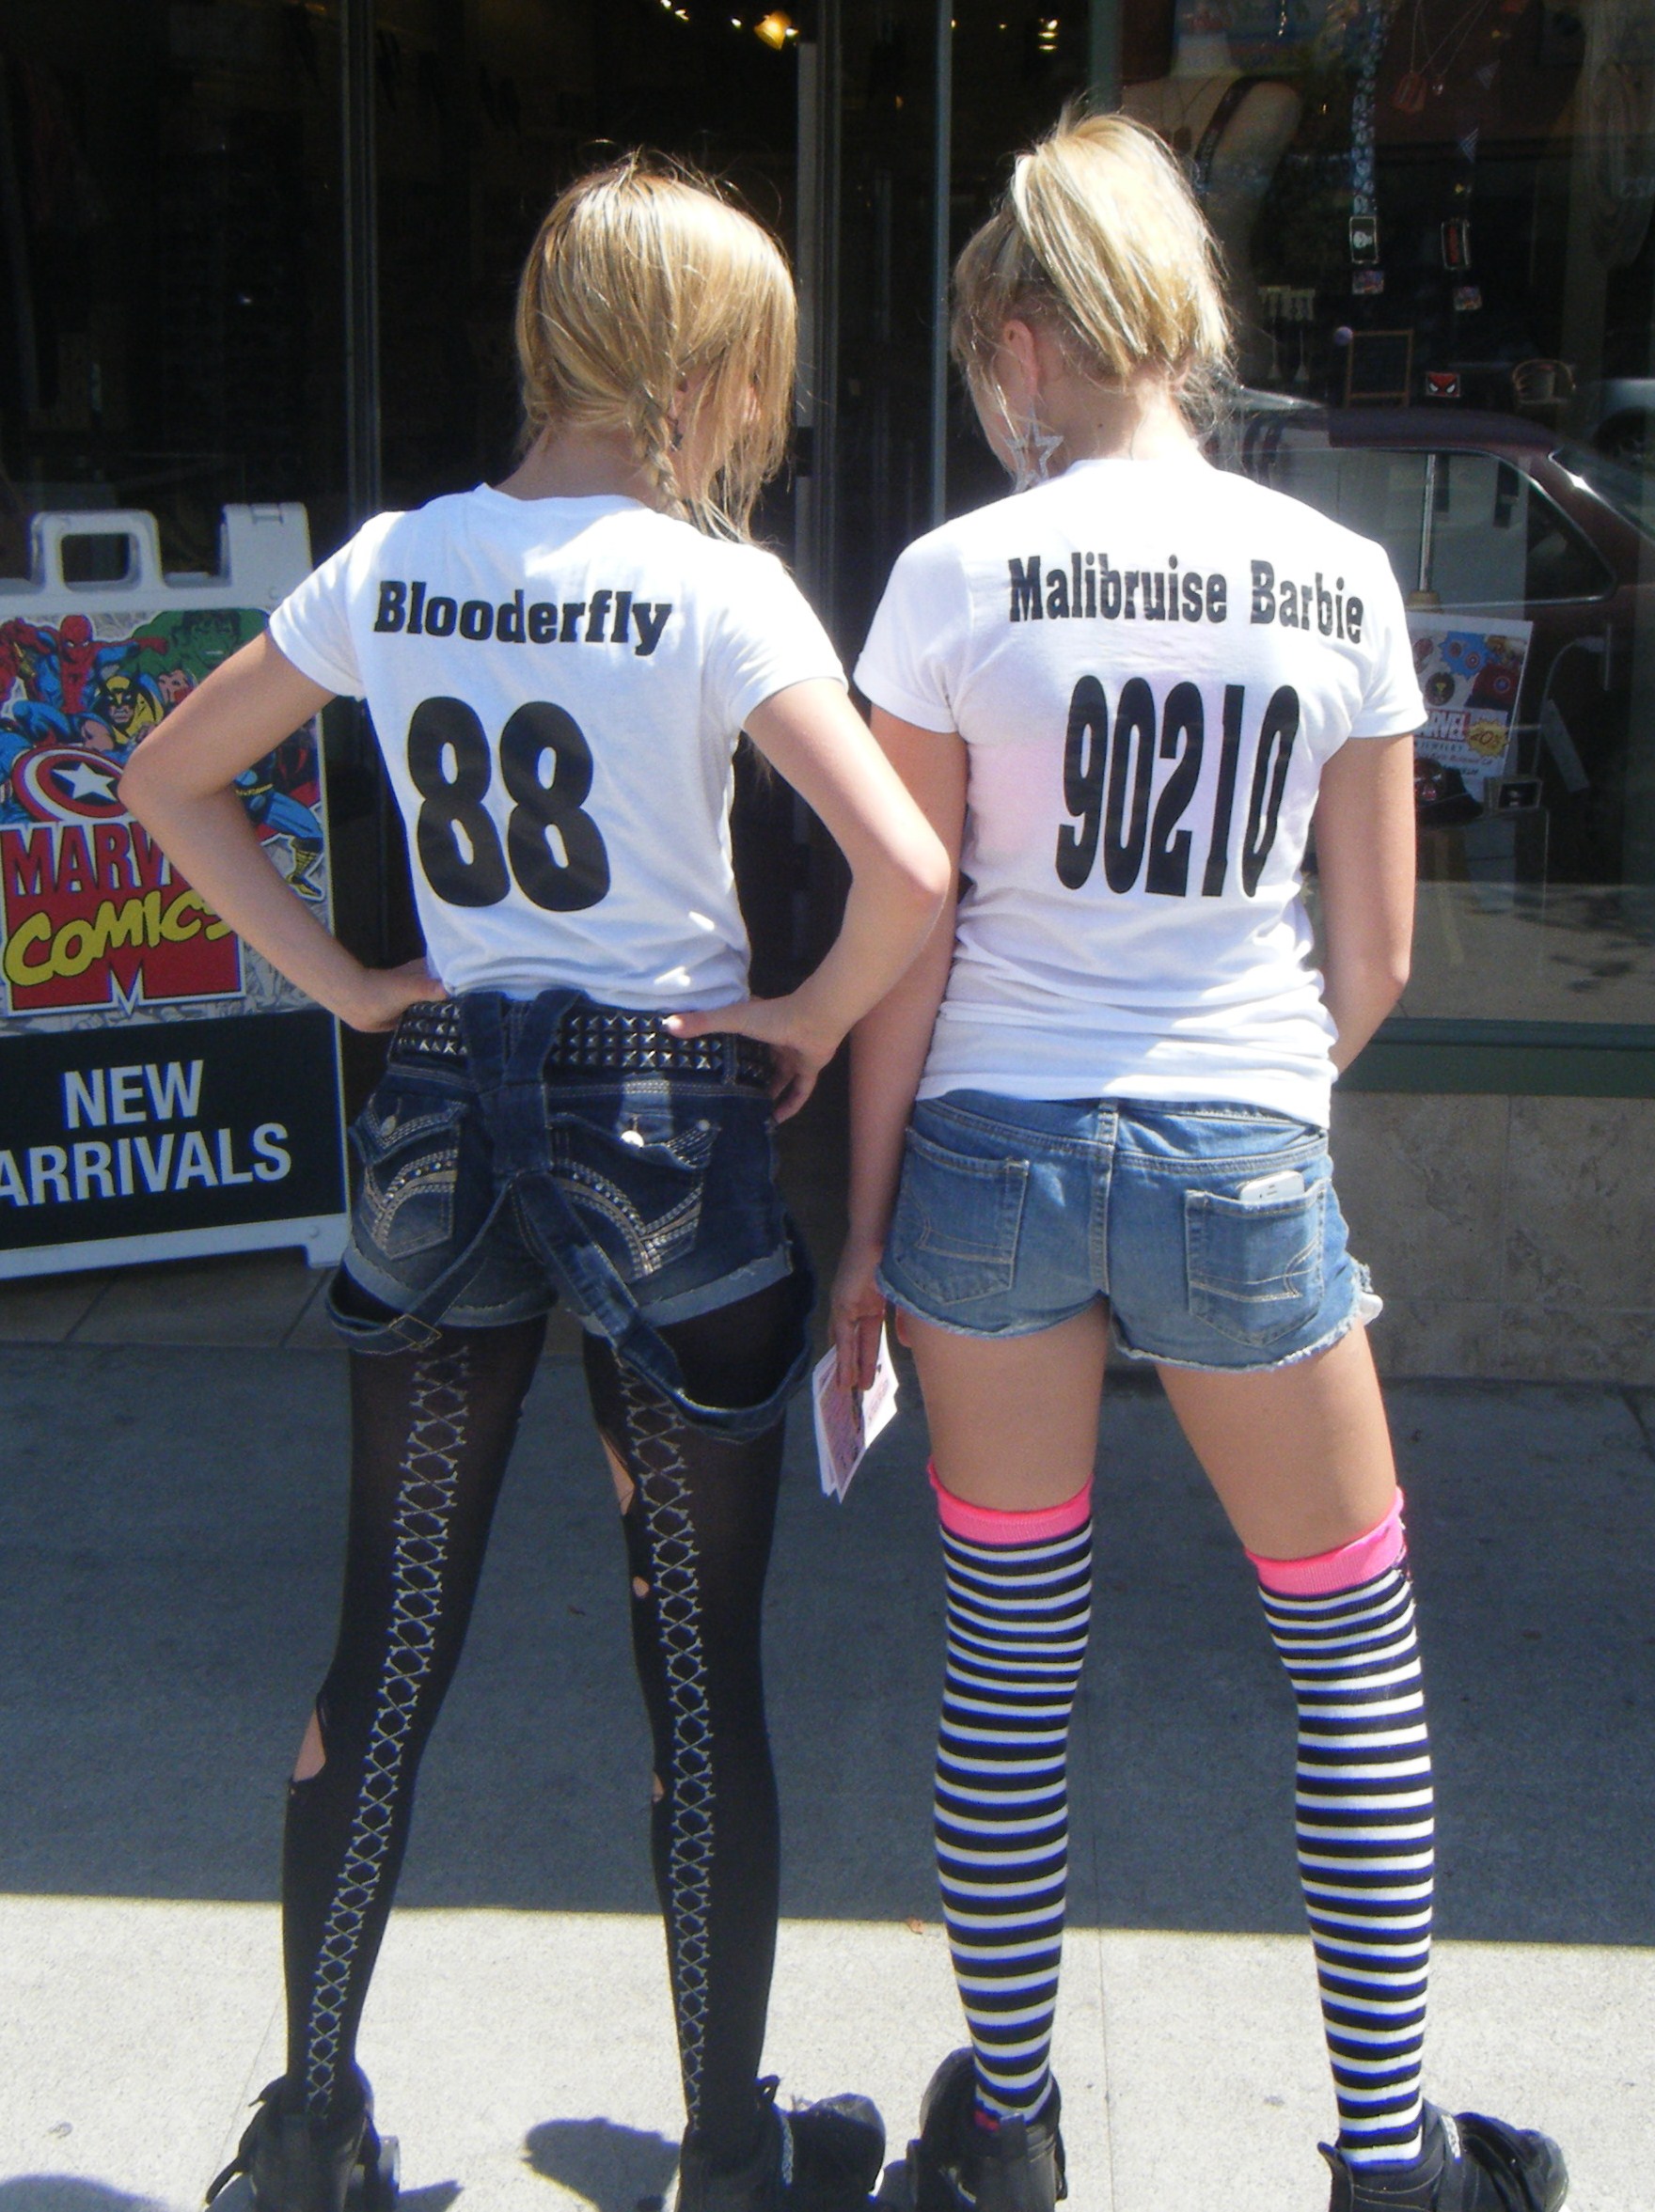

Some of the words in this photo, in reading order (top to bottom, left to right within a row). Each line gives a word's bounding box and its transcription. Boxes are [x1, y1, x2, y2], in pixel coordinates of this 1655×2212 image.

[374, 580, 672, 656] Blooderfly
[1008, 552, 1228, 623] Malibruise
[1250, 559, 1364, 644] Barbie
[407, 696, 611, 913] 88
[1055, 674, 1300, 898] 90210
[1, 820, 171, 895] MARV
[62, 1059, 204, 1129] NEW
[0, 1122, 292, 1207] ARRIVALS
